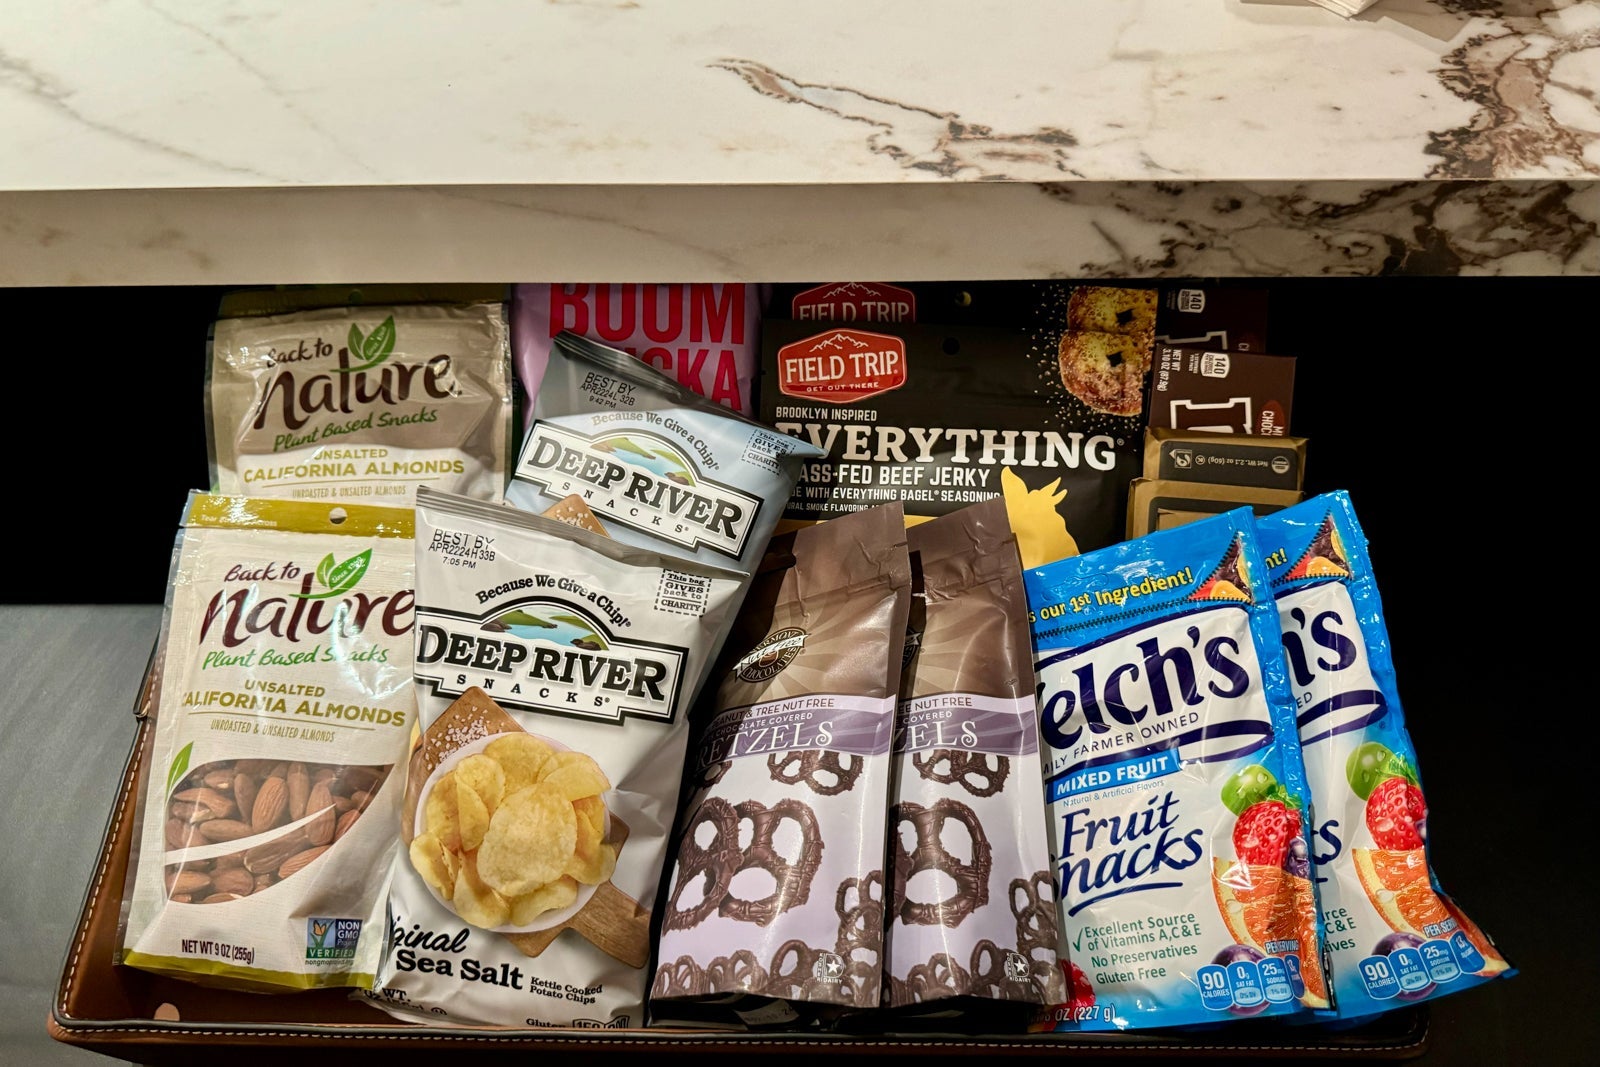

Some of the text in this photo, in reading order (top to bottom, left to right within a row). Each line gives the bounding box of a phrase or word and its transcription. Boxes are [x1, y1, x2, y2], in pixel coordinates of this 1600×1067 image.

[549, 283, 746, 345] BOOM
[314, 338, 333, 357] to
[785, 350, 899, 383] FIELD TRIP
[1213, 357, 1226, 375] 140
[585, 371, 637, 395] BEST BY
[806, 385, 823, 393] GET
[849, 381, 880, 390] THERE
[604, 400, 617, 409] PM
[775, 406, 878, 421] BROOKLYN INSPIRED
[273, 407, 438, 452] Plant Based Snacks
[591, 411, 643, 426] Because
[645, 411, 663, 425] We
[664, 418, 688, 438] Give
[687, 435, 695, 443] a
[314, 448, 389, 460] UNSALTED
[244, 460, 465, 483] CALIFORNIA ALMONDS
[799, 463, 991, 488] ASS-FED BEEF JERKY
[293, 485, 407, 499] UNROASTED & UNSALTED ALMONDS
[527, 435, 745, 540] DEEP RIVER
[805, 486, 830, 499] WITH
[832, 487, 897, 501] EVERYTHING
[561, 481, 684, 534] SNACKS
[806, 503, 829, 512] SMOKE
[433, 528, 496, 550] BEST BY
[223, 561, 300, 582] Back to
[442, 556, 477, 569] 7:05 PM
[475, 577, 534, 604] Because
[534, 574, 556, 588] We
[557, 577, 589, 597] Give
[587, 591, 597, 603] a
[665, 581, 704, 594] GIVES
[667, 572, 706, 587] This bag
[663, 588, 702, 600] back to
[1040, 566, 1194, 620] our 1st Ingredient!
[661, 599, 702, 612] CHARITY
[202, 644, 389, 670] Plant Based Sacks
[416, 624, 667, 702] DEEP RIVER
[244, 679, 325, 697] UNSALTED
[456, 673, 604, 707] SNACKS
[1038, 626, 1250, 750] elch's
[182, 690, 406, 727] ALIFORNIA ALMONDS
[745, 698, 834, 718] & TREE NUT FREE
[915, 697, 973, 711] NUT FREE
[769, 712, 813, 725] COVERED
[903, 710, 953, 724] COVERED
[210, 718, 336, 742] UNROASTED & UNSALTED ALMONDS
[1074, 711, 1199, 759] FARMER OWNED
[1056, 756, 1169, 796] MIXED FRUIT
[1063, 794, 1092, 808] Natural
[1102, 786, 1134, 799] Artificial
[1136, 780, 1165, 791] Flavors
[1059, 790, 1181, 861] Fruit
[1057, 827, 1204, 900] nacks
[337, 930, 359, 939] GMO
[338, 921, 360, 930] NON
[1085, 912, 1196, 939] Excellent Source
[182, 938, 255, 964] NET WT 9 OZ (255g)
[1087, 931, 1156, 951] of Vitamins
[309, 948, 354, 958] VERIFIED
[1091, 943, 1198, 968] No Preservatives
[396, 949, 524, 990] Sea Salt
[1096, 967, 1167, 985] Gluten Free
[1364, 961, 1389, 981] 90
[530, 976, 603, 996] Kettle Cooked
[1202, 971, 1225, 990] 90
[1367, 976, 1396, 989] CALORIES
[529, 985, 596, 1005] Potato Chips
[1202, 988, 1231, 998] CALORIES
[1055, 1008, 1071, 1021] OZ
[1074, 1005, 1100, 1023] (227
